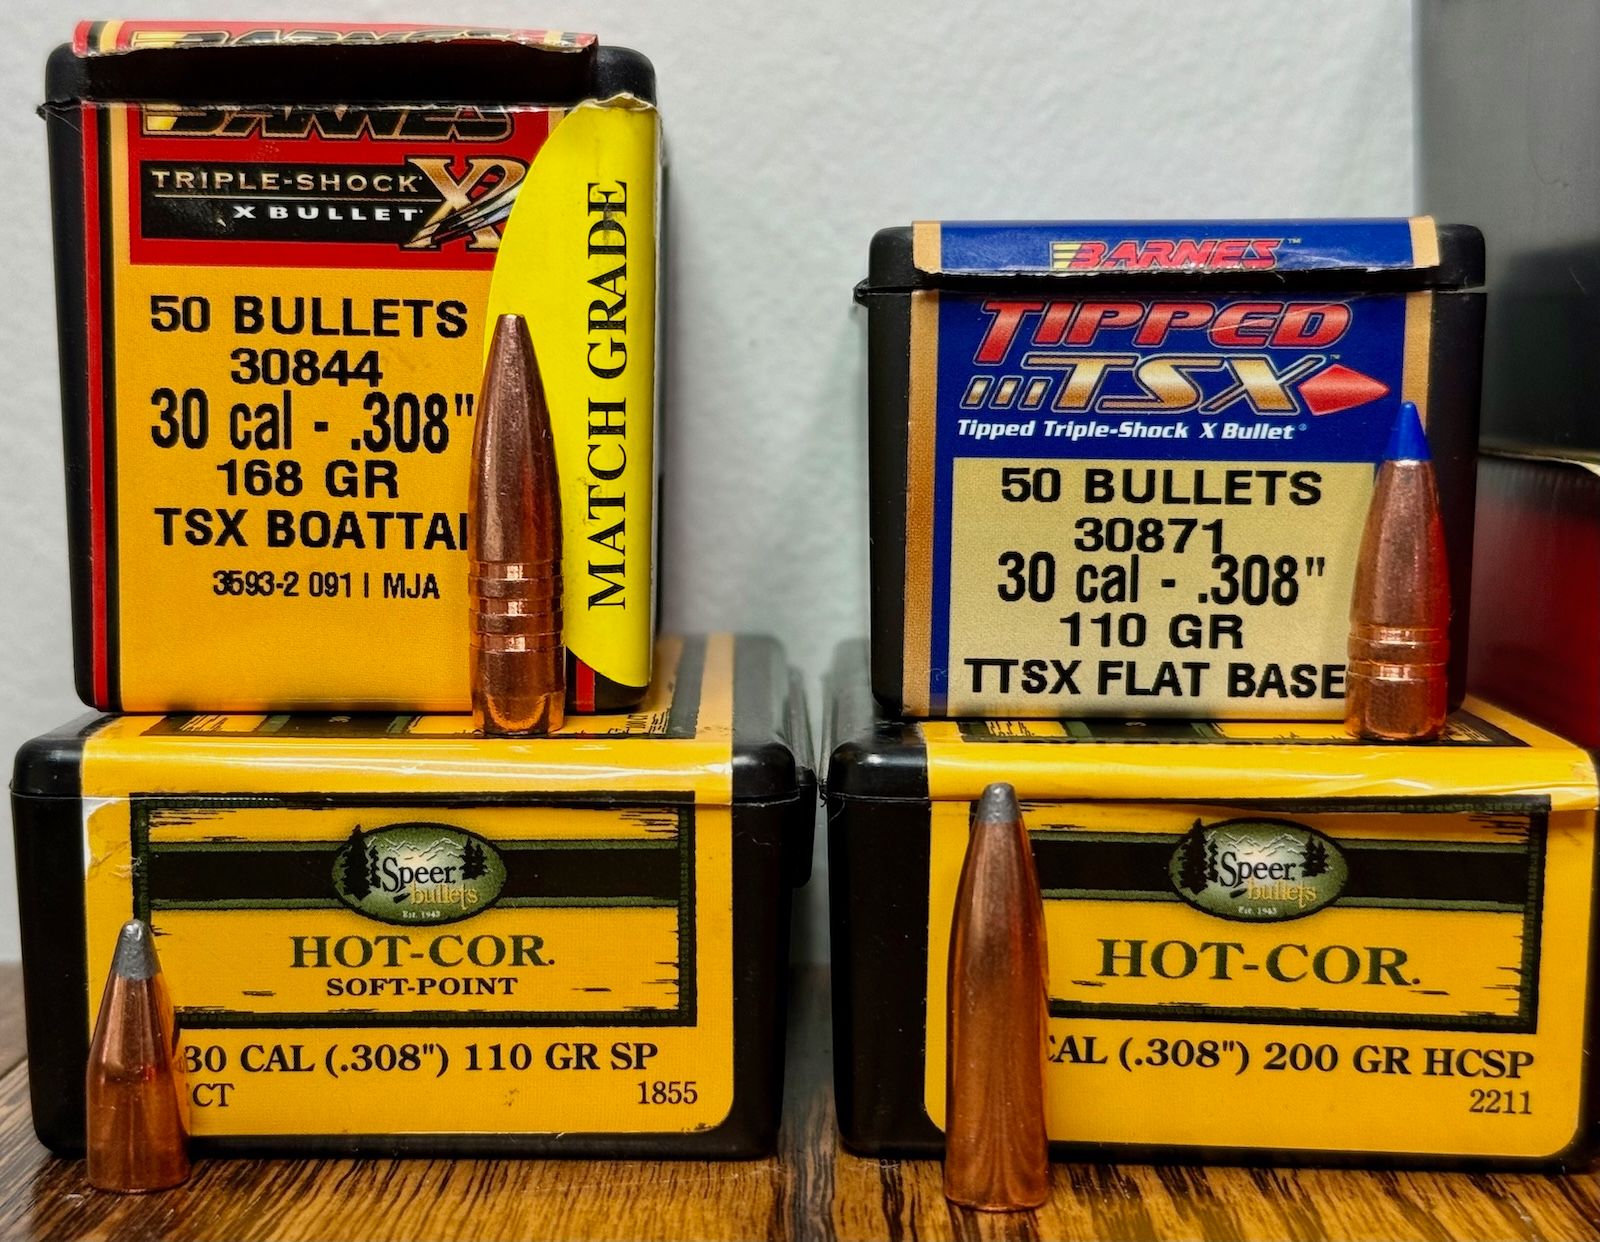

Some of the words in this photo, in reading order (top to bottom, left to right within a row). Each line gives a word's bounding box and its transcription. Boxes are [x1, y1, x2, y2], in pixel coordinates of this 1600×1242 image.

[151, 171, 419, 192] TRIPLE-SHOCK
[233, 205, 256, 219] X
[269, 206, 418, 222] BULLET
[587, 180, 628, 379] GRADE
[150, 295, 211, 332] 50
[234, 295, 468, 338] BULLETS
[973, 301, 1353, 366] TIPPED
[230, 347, 384, 388] 30844
[1022, 353, 1327, 415] TSX
[150, 387, 209, 450] 30
[229, 390, 292, 451] cal
[351, 393, 475, 454] .308"
[957, 419, 1035, 440] Tipped
[1043, 420, 1189, 440] Triple-Shock
[1199, 422, 1217, 438] X
[1221, 422, 1294, 440] Bullet
[216, 458, 303, 497] 168
[325, 459, 400, 499] GR
[1001, 467, 1062, 503] 50
[1084, 468, 1323, 506] BULLETS
[587, 396, 628, 611] MATCH
[154, 507, 248, 547] TSX
[267, 509, 468, 550] BOATTAI
[1074, 517, 1225, 554] 30871
[383, 572, 440, 599] MJA
[997, 551, 1056, 603] 30
[1075, 555, 1140, 604] cal
[1197, 554, 1325, 607] .308"
[1059, 612, 1147, 648] 110
[1168, 613, 1244, 650] GR
[963, 657, 1082, 695] TTSX
[1097, 660, 1211, 698] FLAT
[1227, 662, 1347, 699] BASE
[409, 881, 480, 911] bullets
[1247, 877, 1317, 909] bullets
[326, 977, 518, 996] SOFT-POINT
[184, 1044, 228, 1073] 30
[240, 1043, 316, 1073] CAL
[325, 1043, 449, 1079] (.308")
[465, 1043, 532, 1071] 110
[545, 1042, 601, 1070] GR
[611, 1042, 659, 1070] SP
[1048, 1034, 1109, 1064] AL
[1118, 1036, 1250, 1077] (.308")
[1263, 1042, 1339, 1072] 200
[1353, 1045, 1412, 1075] GR
[1422, 1048, 1535, 1079] HCSP
[192, 1082, 235, 1107] CT
[637, 1081, 698, 1105] 1855
[1469, 1088, 1533, 1115] 2211
